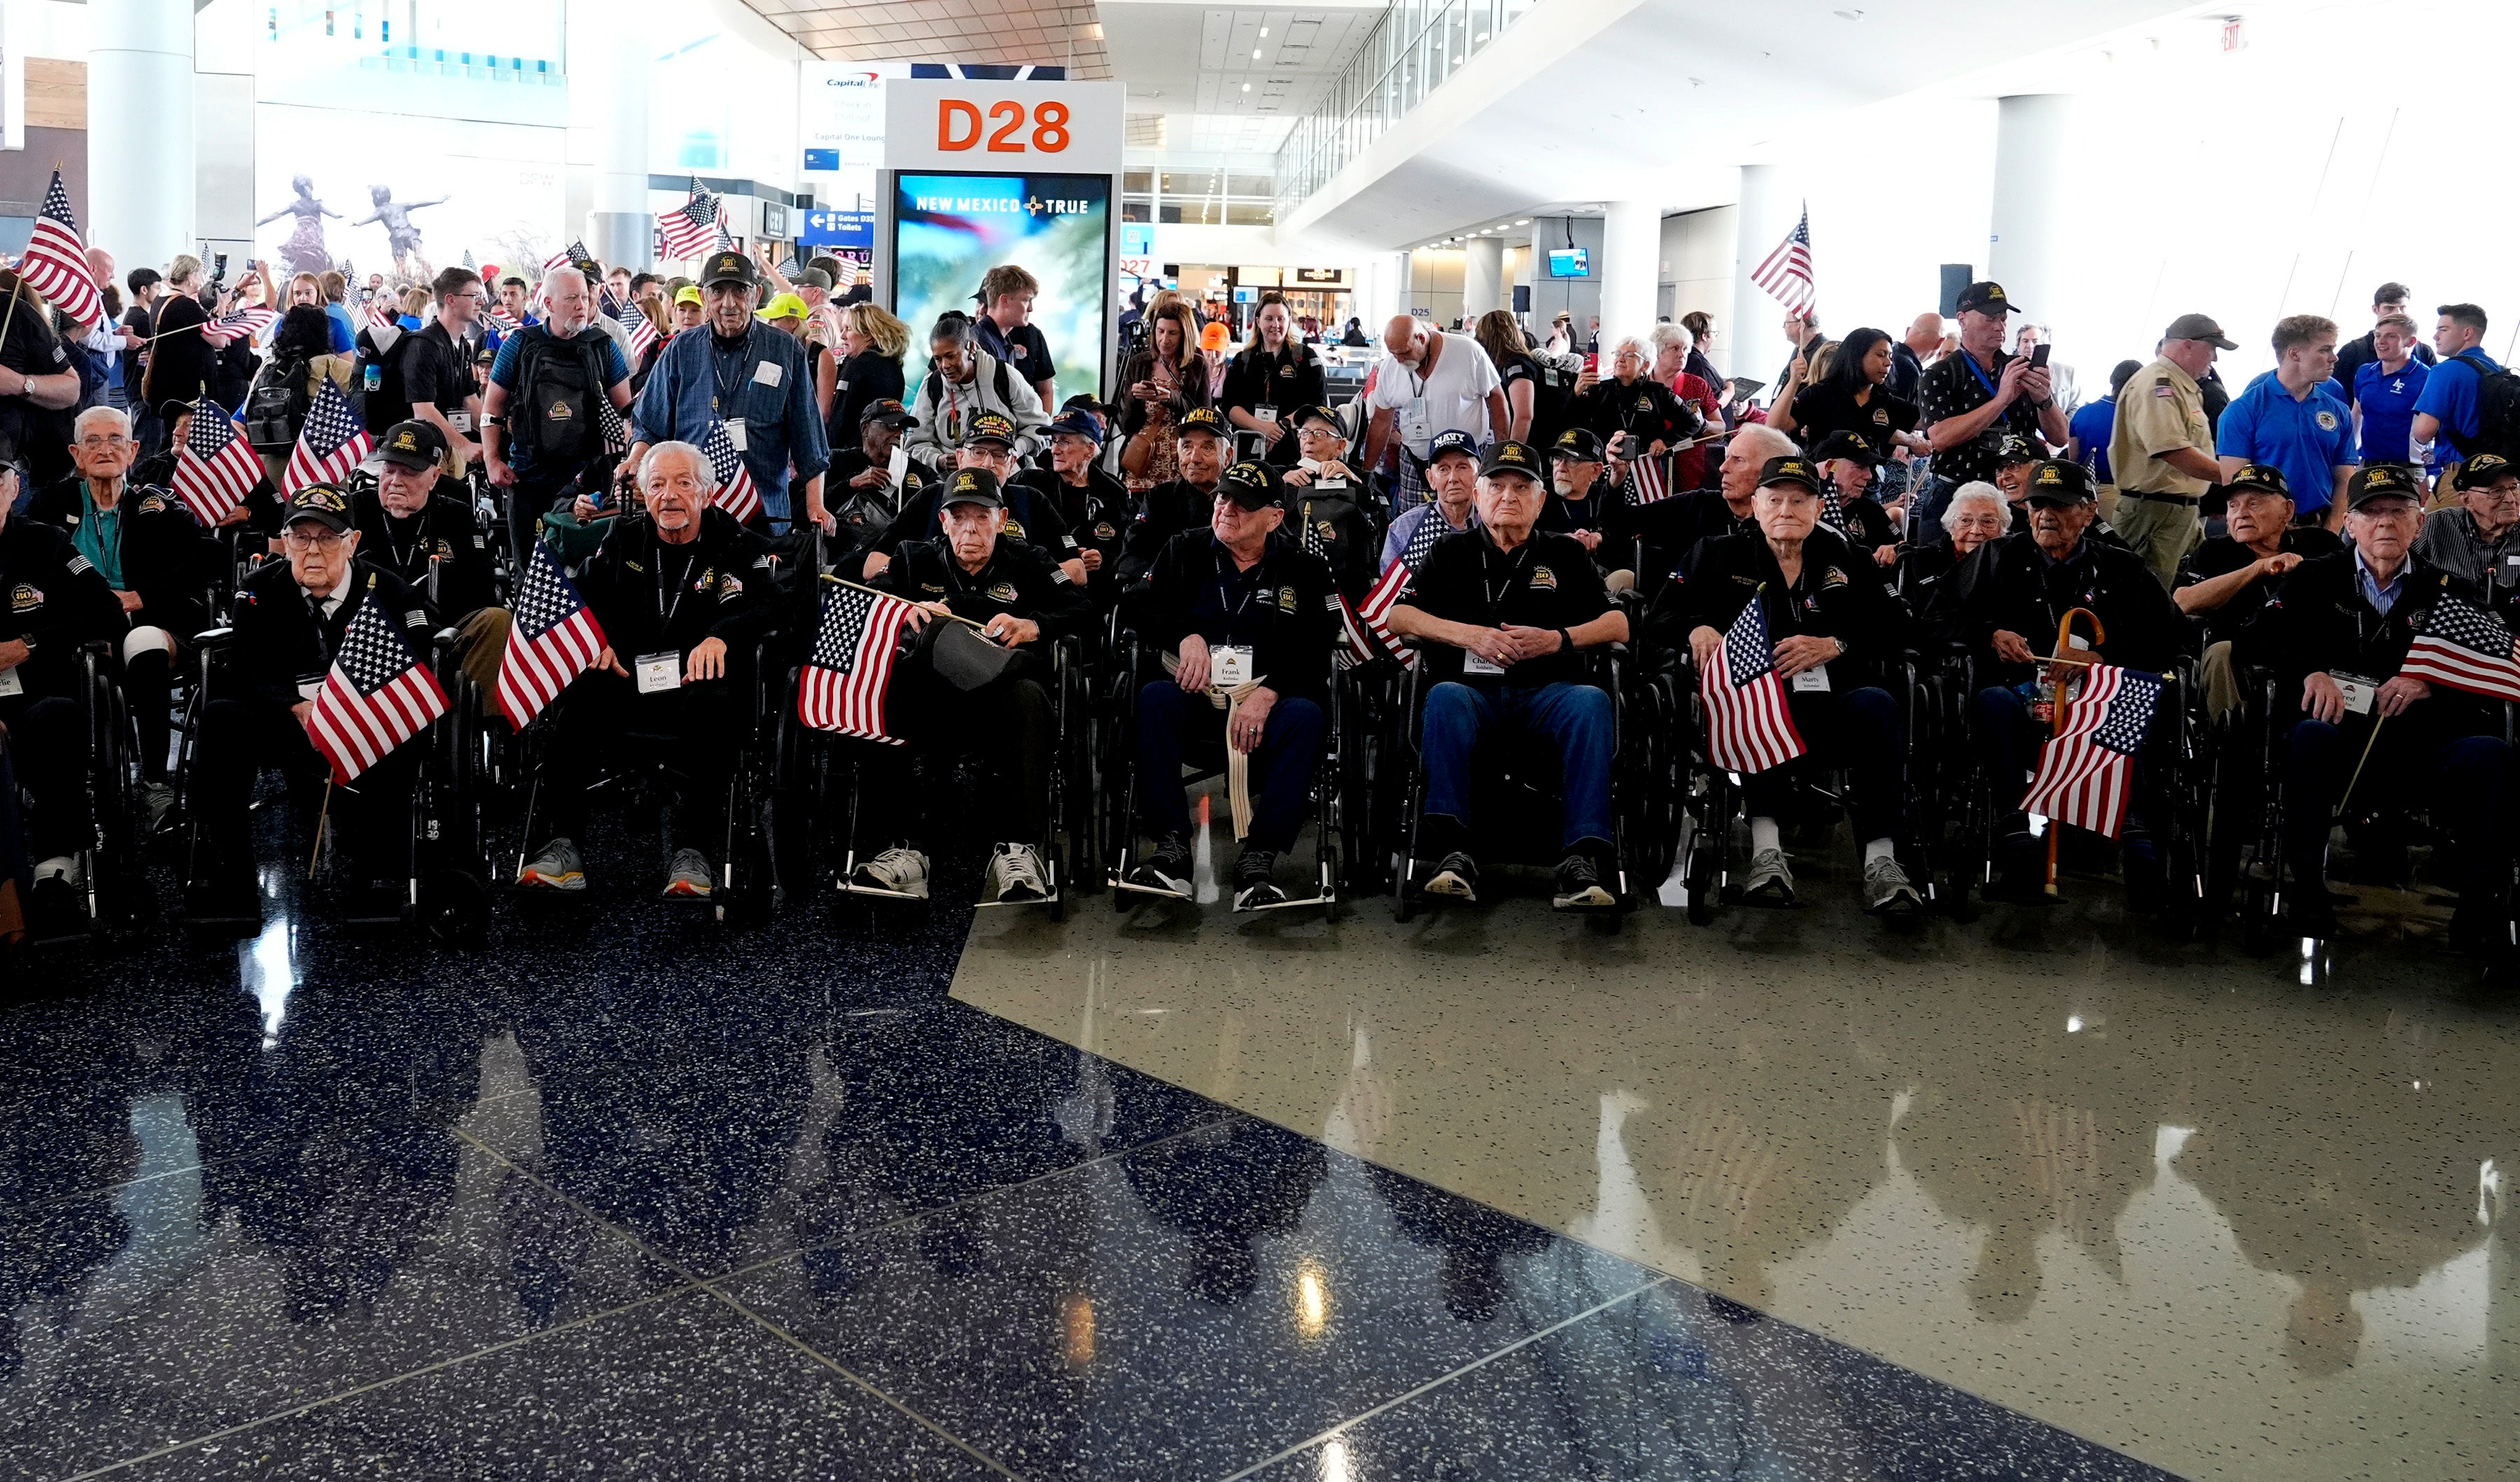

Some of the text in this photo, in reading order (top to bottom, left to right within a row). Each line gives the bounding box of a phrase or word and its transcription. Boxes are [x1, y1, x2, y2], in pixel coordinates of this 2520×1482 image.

[2224, 25, 2240, 51] EXIT
[937, 99, 1070, 153] D28
[815, 132, 842, 141] Capital
[862, 134, 886, 144] Loung
[916, 196, 1088, 214] NEW MEXICO TRUE
[1411, 308, 1430, 317] D25
[1434, 432, 1466, 448] NAVY
[15, 592, 31, 600] 80
